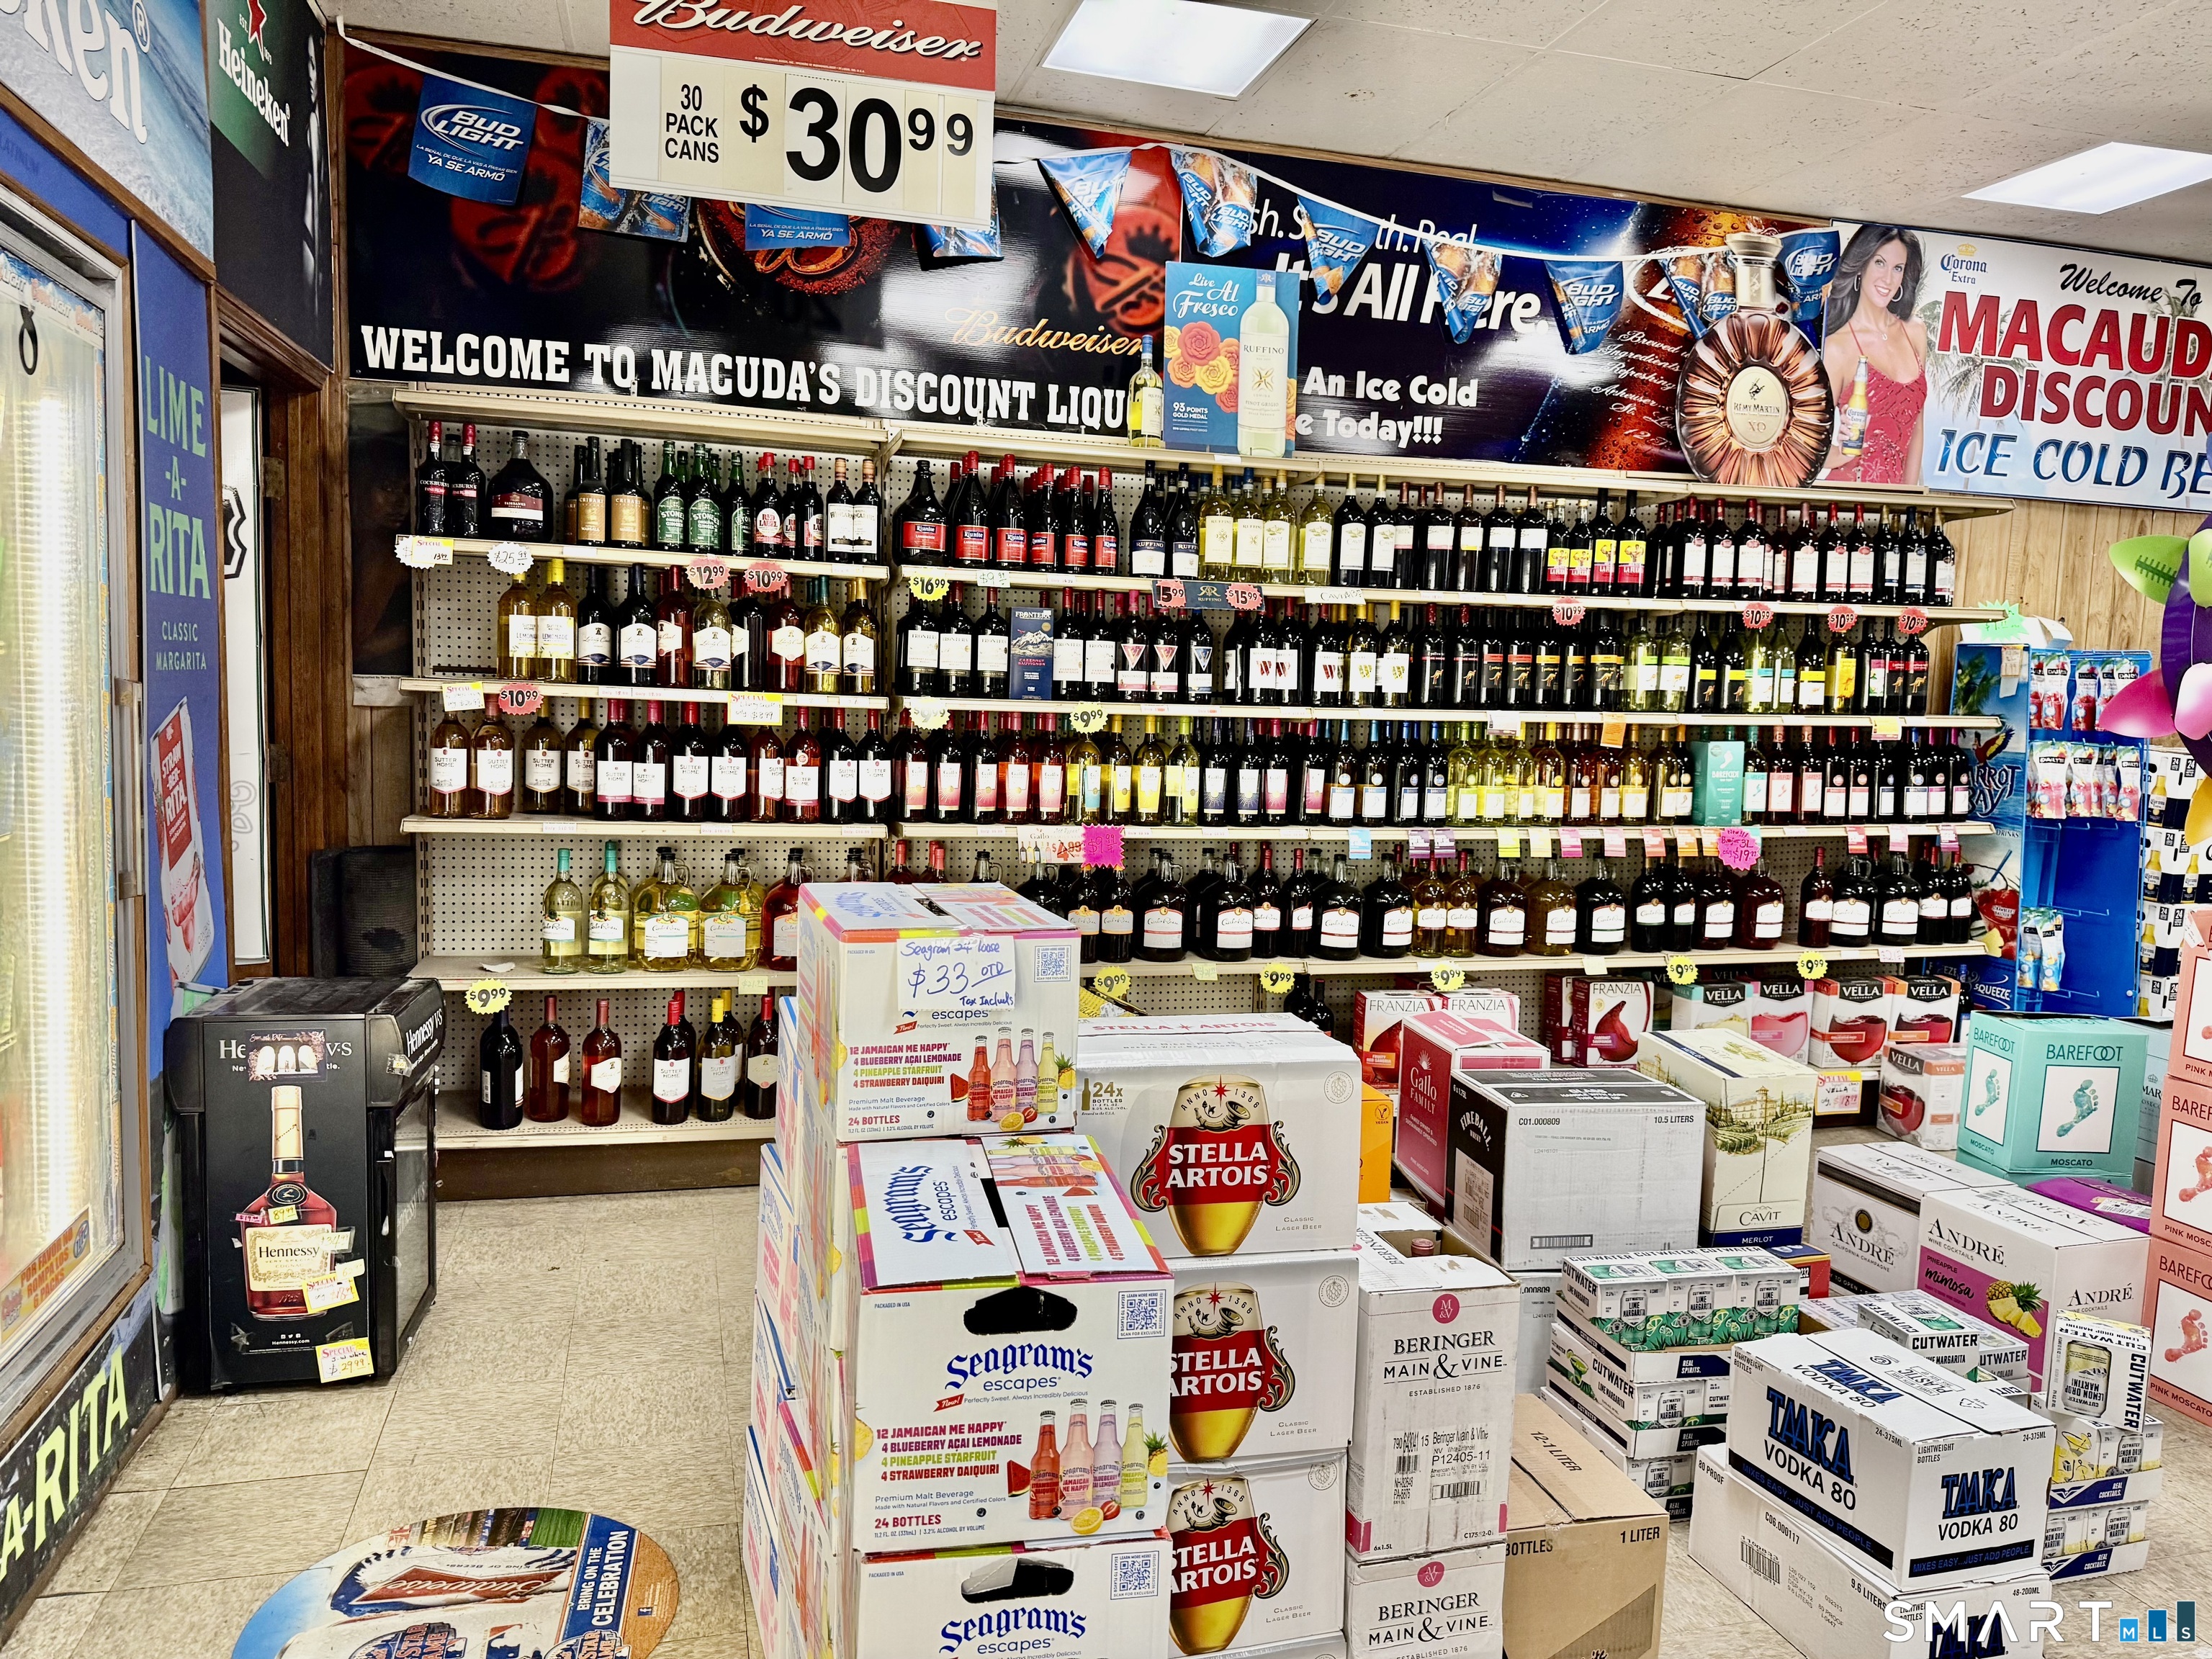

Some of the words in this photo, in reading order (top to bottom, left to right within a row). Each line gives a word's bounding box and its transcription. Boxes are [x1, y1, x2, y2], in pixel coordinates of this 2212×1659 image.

[631, 0, 982, 62] Budweiser
[217, 17, 289, 146] Heineken
[680, 84, 702, 110] 30
[451, 110, 521, 137] BUD
[665, 112, 719, 138] PACK
[433, 120, 523, 150] LIGHT
[665, 140, 719, 163] CANS
[428, 153, 443, 166] YA
[445, 161, 465, 172] SE
[464, 166, 505, 181] ARMÓ
[1940, 253, 1987, 274] Corona
[1188, 273, 1215, 287] Live
[1206, 280, 1239, 302] Al
[1951, 271, 1976, 284] Extra
[2059, 263, 2163, 302] Welcome
[2175, 278, 2203, 307] To
[1344, 263, 1420, 322] All
[1173, 290, 1238, 319] Fresco
[1938, 291, 2212, 380] MACAUD
[1244, 344, 1285, 355] RUFFINO
[361, 325, 570, 383] WELCOME
[584, 343, 637, 389] TO
[650, 347, 842, 405] MACUDA'S
[855, 367, 1035, 421] DISCOUNT
[1303, 365, 1345, 396] An
[1355, 369, 1401, 403] Ice
[1408, 374, 1478, 408] Cold
[145, 355, 207, 458] LIME
[1173, 402, 1186, 413] 93
[1733, 402, 1752, 415] RÉMY
[1753, 403, 1781, 415] MARTIN
[1308, 408, 1443, 448] Today!!!
[1748, 421, 1766, 433] XO
[1938, 428, 2018, 477] ICE
[2033, 439, 2148, 487] COLD
[148, 501, 212, 601] RITA
[162, 620, 199, 643] CLASSIC
[156, 651, 207, 671] MARGARITA
[901, 942, 950, 961] Seagram
[977, 943, 999, 953] loose
[1593, 982, 1642, 996] FRANZIA
[1705, 988, 1743, 1002] VELLA
[1910, 986, 1948, 997] VELLA
[1974, 983, 2011, 1000] SQUEEZE
[1369, 999, 1426, 1013] FRANZIA
[2046, 1043, 2124, 1064] BAREFOOT
[1411, 1066, 1437, 1101] Gallo
[1180, 1089, 1209, 1112] ANNO
[1234, 1088, 1260, 1109] 1366
[1410, 1091, 1437, 1115] FAMILY
[1460, 1110, 1491, 1148] FIREBALL
[1519, 1118, 1560, 1126] C01.000809
[1653, 1115, 1668, 1124] 10.5
[1670, 1115, 1694, 1124] LITERS
[1167, 1141, 1269, 1165] STELLA
[2050, 1158, 2093, 1167] MOSCATO
[1164, 1165, 1269, 1189] ARTOIS
[1739, 1208, 1782, 1226] CAVIT
[1741, 1234, 1774, 1244] MERLOT
[1928, 1218, 2005, 1265] ANDRÉ
[258, 1246, 320, 1259] Hennessy
[1926, 1255, 1958, 1274] PINEAPPLE
[1563, 1262, 1597, 1297] CUTWATER
[1924, 1267, 1975, 1299] mimosa
[322, 1344, 353, 1359] SPECIAL
[1393, 1331, 1496, 1355] BERINGER
[1912, 1334, 1978, 1349] CUTWATER
[945, 1343, 1094, 1390] Seagram's
[1384, 1362, 1429, 1379] MAIN
[1433, 1354, 1460, 1379] &
[1462, 1355, 1503, 1371] VINE
[983, 1376, 1058, 1392] escapes
[1409, 1385, 1461, 1397] ESTABLISHED
[2123, 1352, 2146, 1434] CUTWATER
[1033, 1391, 1061, 1400] Incredibly
[876, 1429, 889, 1439] 12
[891, 1425, 946, 1439] JAMAICAN
[949, 1424, 965, 1435] ME
[1766, 1385, 1855, 1485] TAAKA
[2023, 1431, 2046, 1442] 24-375ML
[882, 1443, 888, 1453] 4
[890, 1439, 946, 1453] BLUEBERRY
[972, 1434, 1022, 1447] LEMONADE
[1917, 1443, 1954, 1455] LIGHTWEIGHT
[881, 1457, 888, 1467] 4
[890, 1454, 943, 1467] PINEAPPLE
[945, 1450, 997, 1464] STARFRUIT
[1431, 1450, 1491, 1466] P12405-11
[1917, 1454, 1941, 1464] BOTTLES
[881, 1471, 887, 1481] 4
[889, 1467, 955, 1481] STRAWBERRY
[957, 1464, 999, 1478] DAIQUIRI
[1763, 1439, 1825, 1494] VODKA
[1830, 1481, 1856, 1510] 80
[935, 1491, 974, 1499] Beverage
[875, 1519, 889, 1529] 24
[892, 1515, 942, 1527] BOTTLES
[1620, 1531, 1626, 1543] 1
[1630, 1527, 1660, 1543] LITER
[588, 1547, 603, 1565] THE
[583, 1565, 598, 1581] ON
[591, 1530, 629, 1627] CELEBRATION
[577, 1581, 596, 1611] BRING
